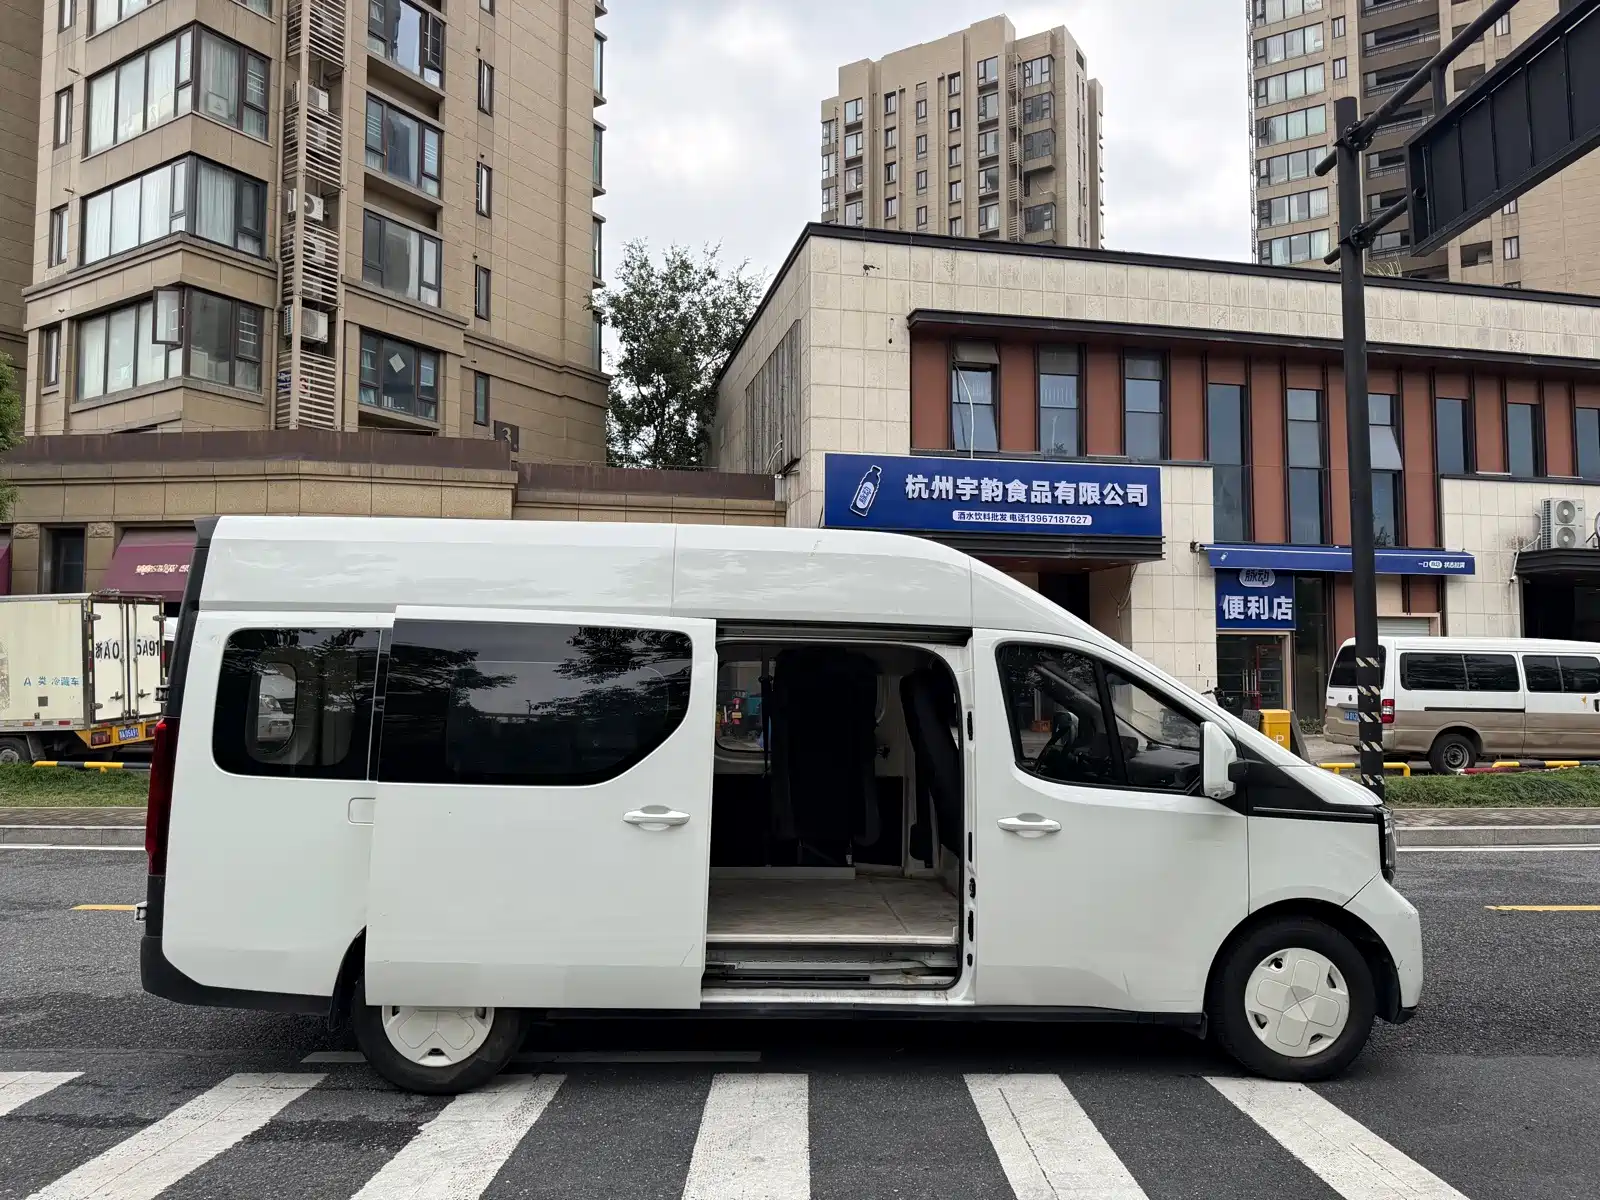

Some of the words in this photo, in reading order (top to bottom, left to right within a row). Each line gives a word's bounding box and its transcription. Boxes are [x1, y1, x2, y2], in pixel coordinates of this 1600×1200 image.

[905, 473, 1148, 507] 杭州宇韵食品有限公司
[957, 511, 1008, 522] 酒水饮料批发
[1009, 513, 1088, 524] 电话13967187627
[1222, 595, 1293, 621] 便利店
